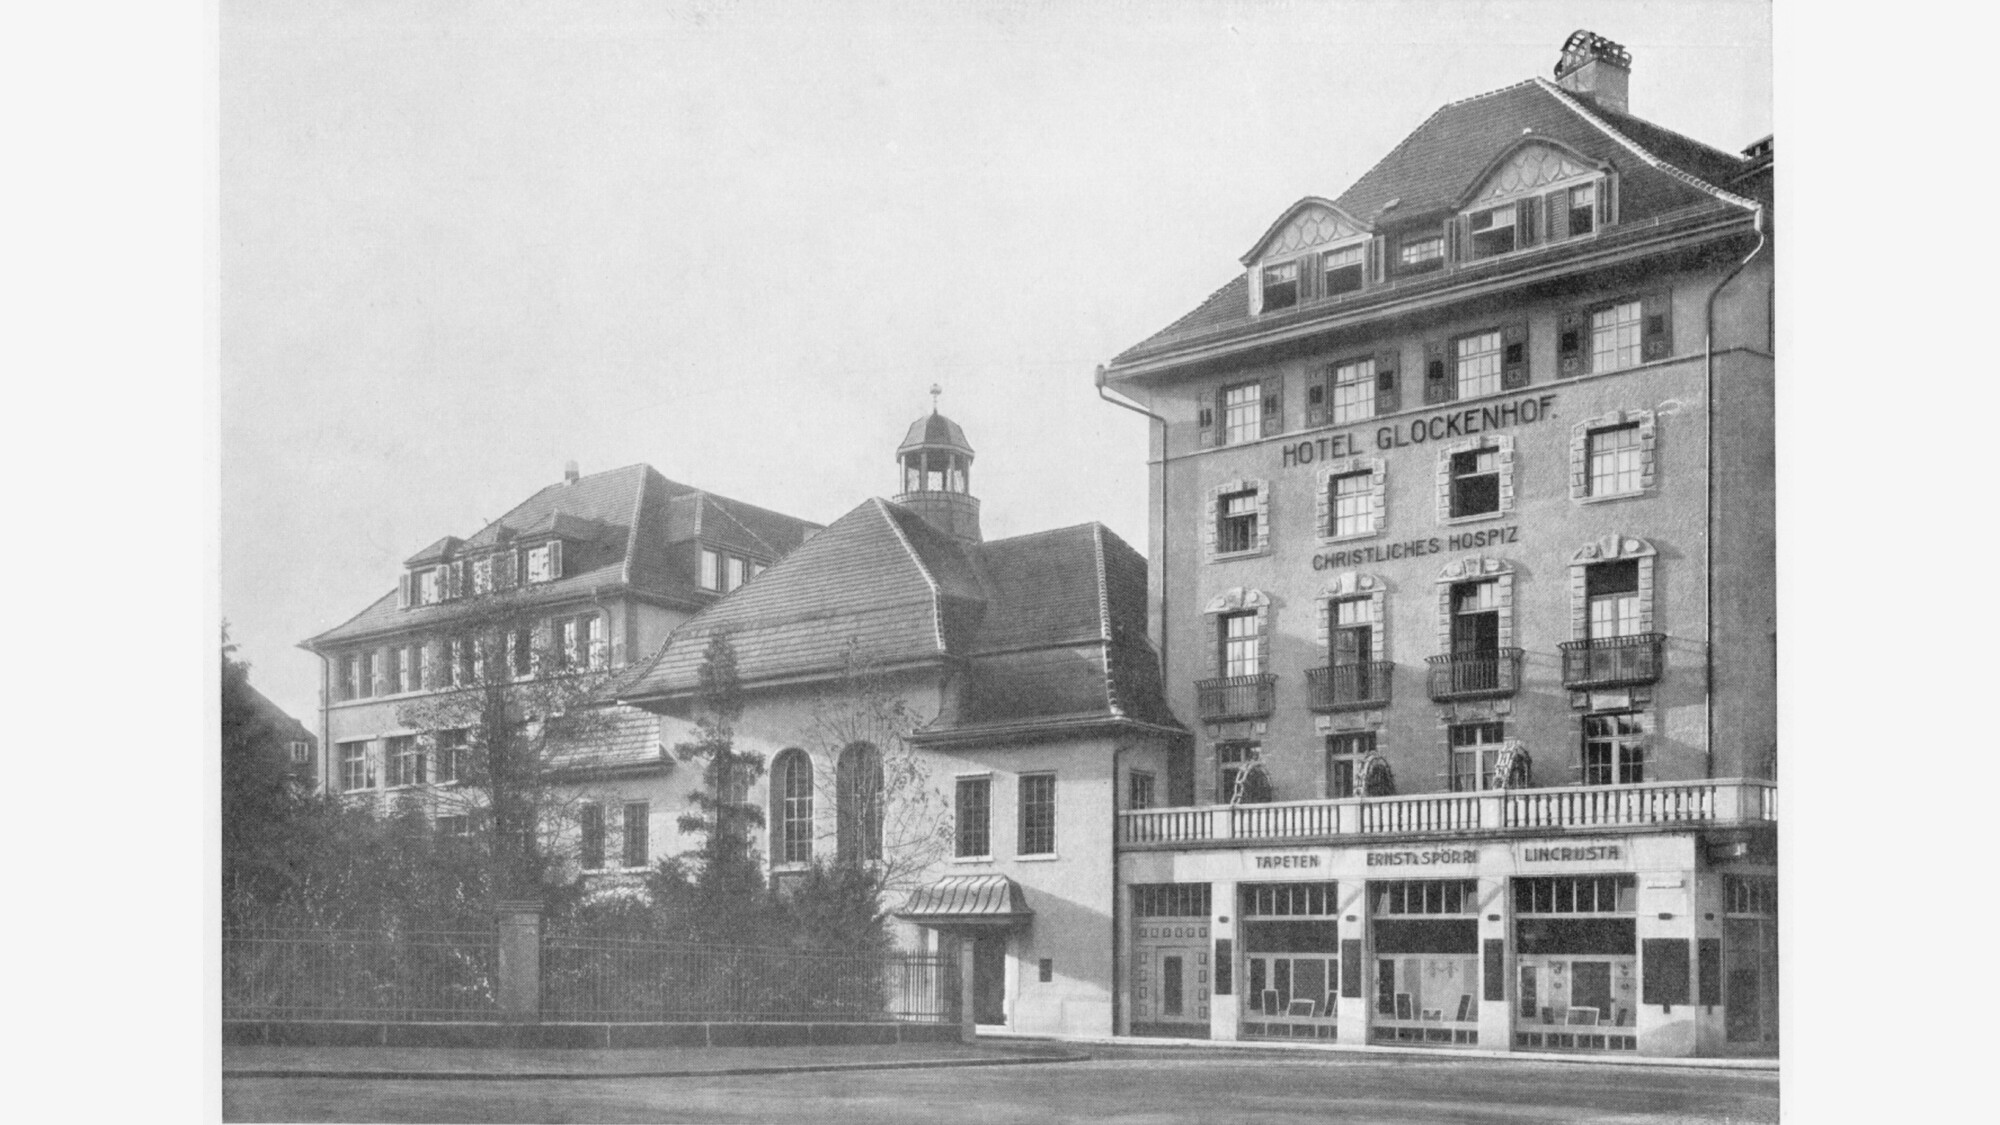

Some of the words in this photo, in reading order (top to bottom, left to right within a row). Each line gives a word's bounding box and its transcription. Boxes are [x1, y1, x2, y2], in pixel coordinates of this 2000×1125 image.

[1282, 432, 1363, 468] HOTEL
[1312, 538, 1440, 571] CHRISTLICHES
[1449, 526, 1519, 552] HOSPIZ
[1255, 854, 1320, 869] TAPETEN
[1525, 845, 1620, 862] LINCRUSTA
